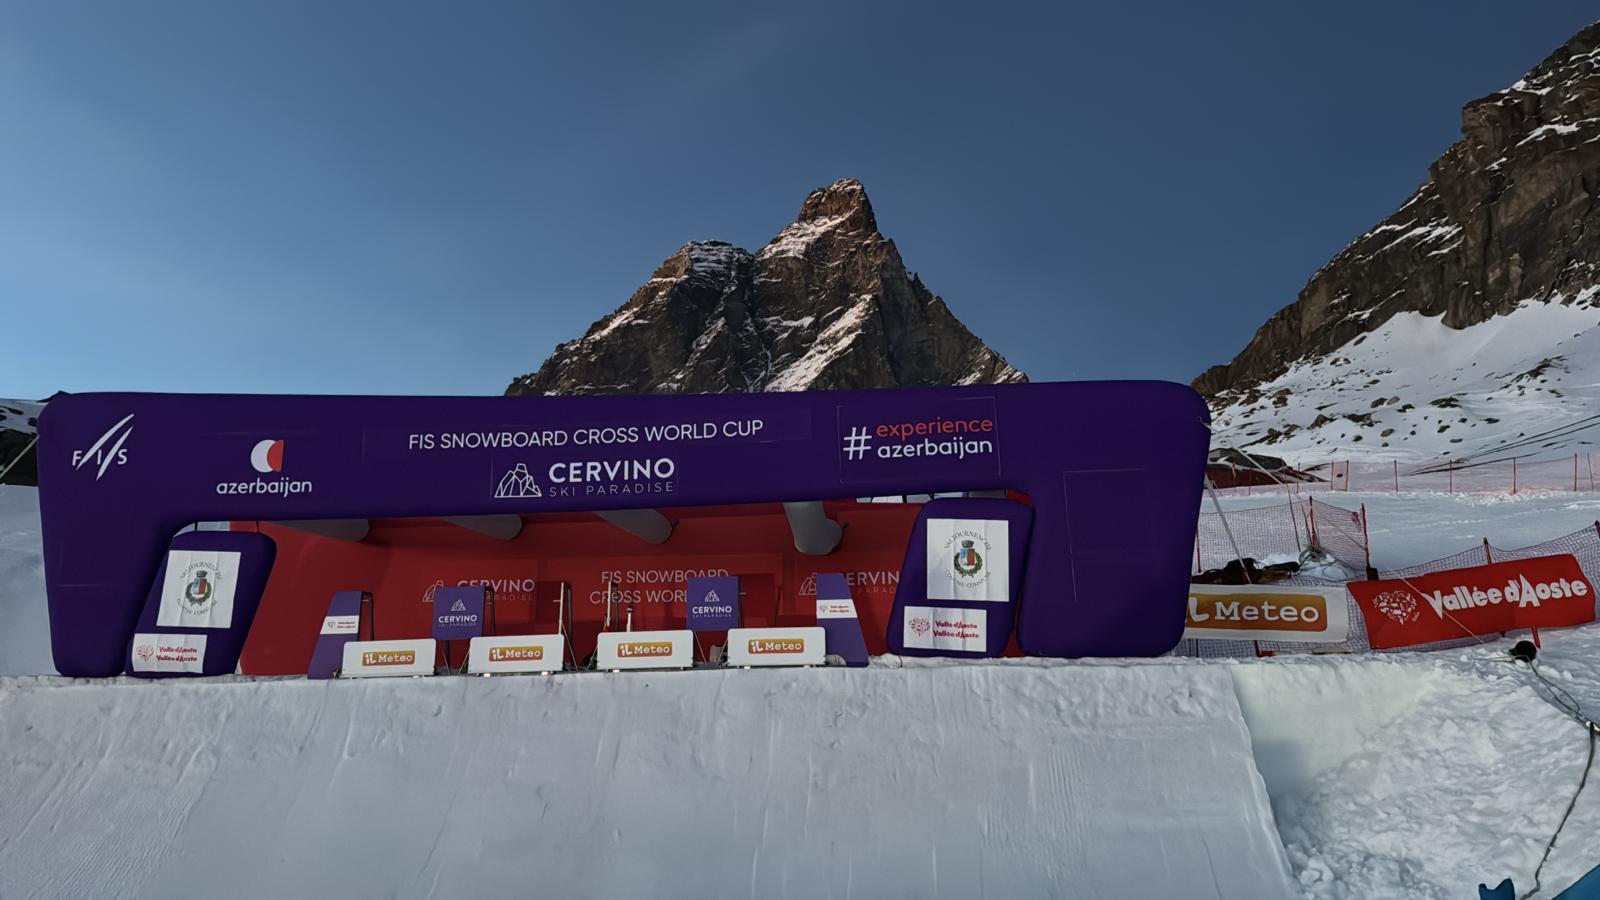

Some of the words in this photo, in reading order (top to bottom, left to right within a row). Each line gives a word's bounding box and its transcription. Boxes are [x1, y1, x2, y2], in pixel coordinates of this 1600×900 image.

[408, 434, 435, 450] FIS
[440, 430, 568, 449] SNOWBOARD
[573, 427, 639, 445] CROSS
[644, 422, 718, 442] WORLD
[723, 419, 764, 436] CUP
[876, 416, 993, 441] experience
[877, 436, 993, 460] azerbaijan
[549, 457, 675, 483] CERVINO
[216, 476, 312, 497] azerbaijan
[549, 485, 577, 497] SKI
[586, 481, 674, 496] PARADISE
[601, 570, 623, 584] FIS
[846, 571, 900, 586] ERVIN
[691, 605, 733, 615] CERVINO
[1422, 585, 1503, 620] Vallée
[438, 614, 477, 624] CERVINO
[1214, 600, 1320, 623] Meteo
[505, 649, 541, 659] Meteo
[634, 644, 670, 655] Meteo
[765, 641, 802, 652] Meteo
[378, 653, 413, 663] Meteo
